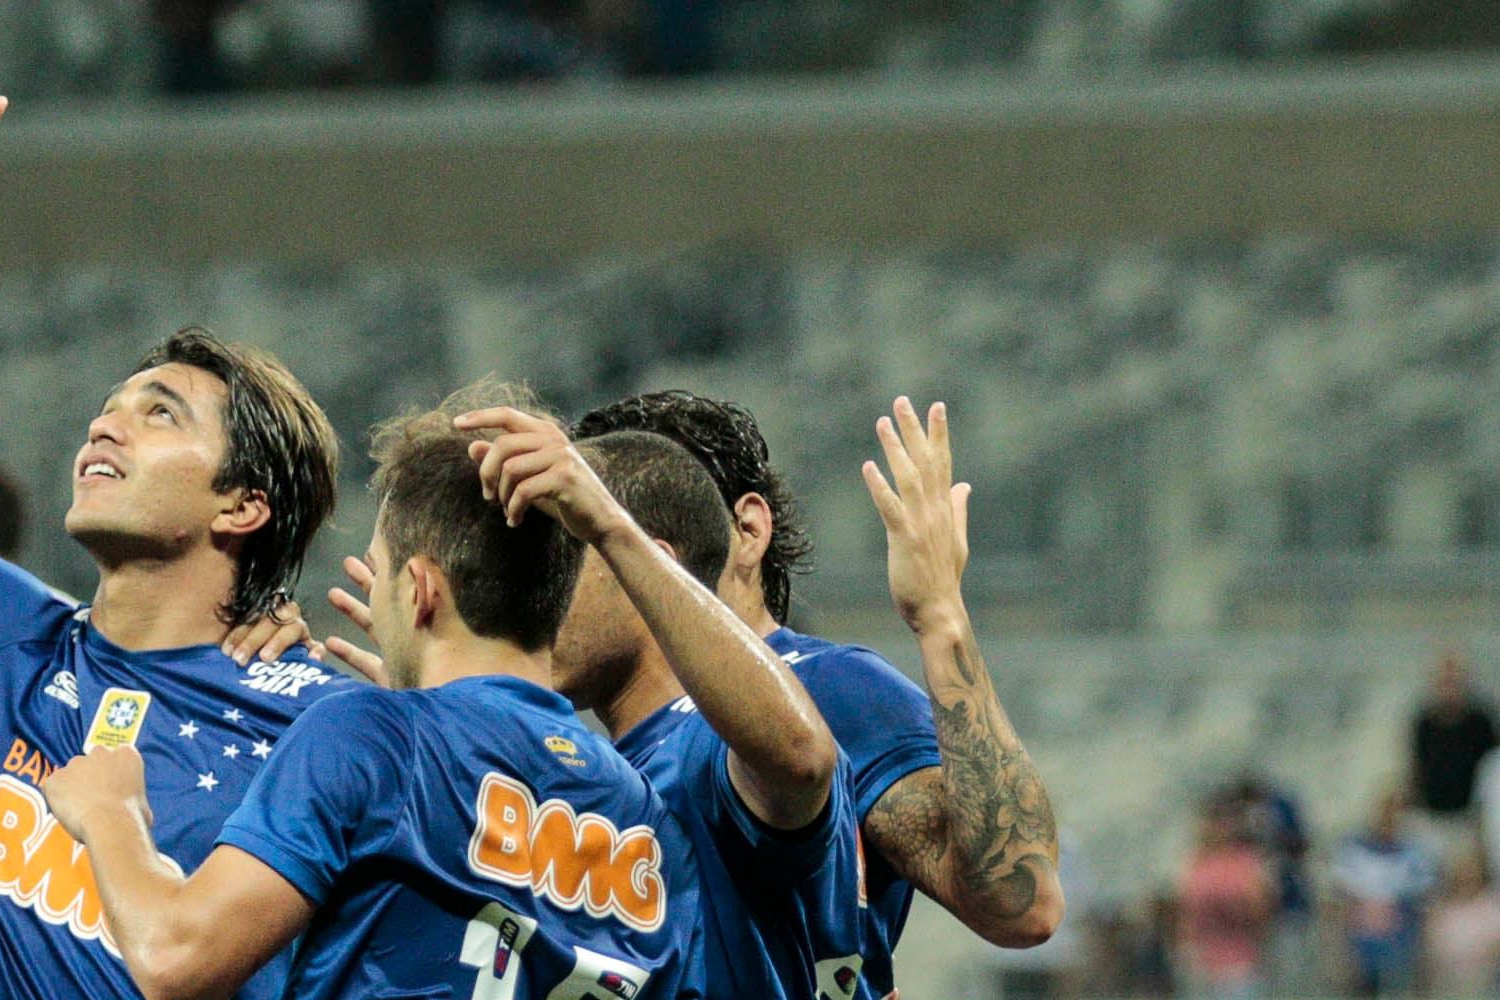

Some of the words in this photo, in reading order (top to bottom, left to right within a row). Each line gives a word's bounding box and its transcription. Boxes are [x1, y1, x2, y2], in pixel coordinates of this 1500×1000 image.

[239, 674, 311, 698] MIX
[3, 737, 60, 788] BAN
[467, 771, 667, 934] BMG
